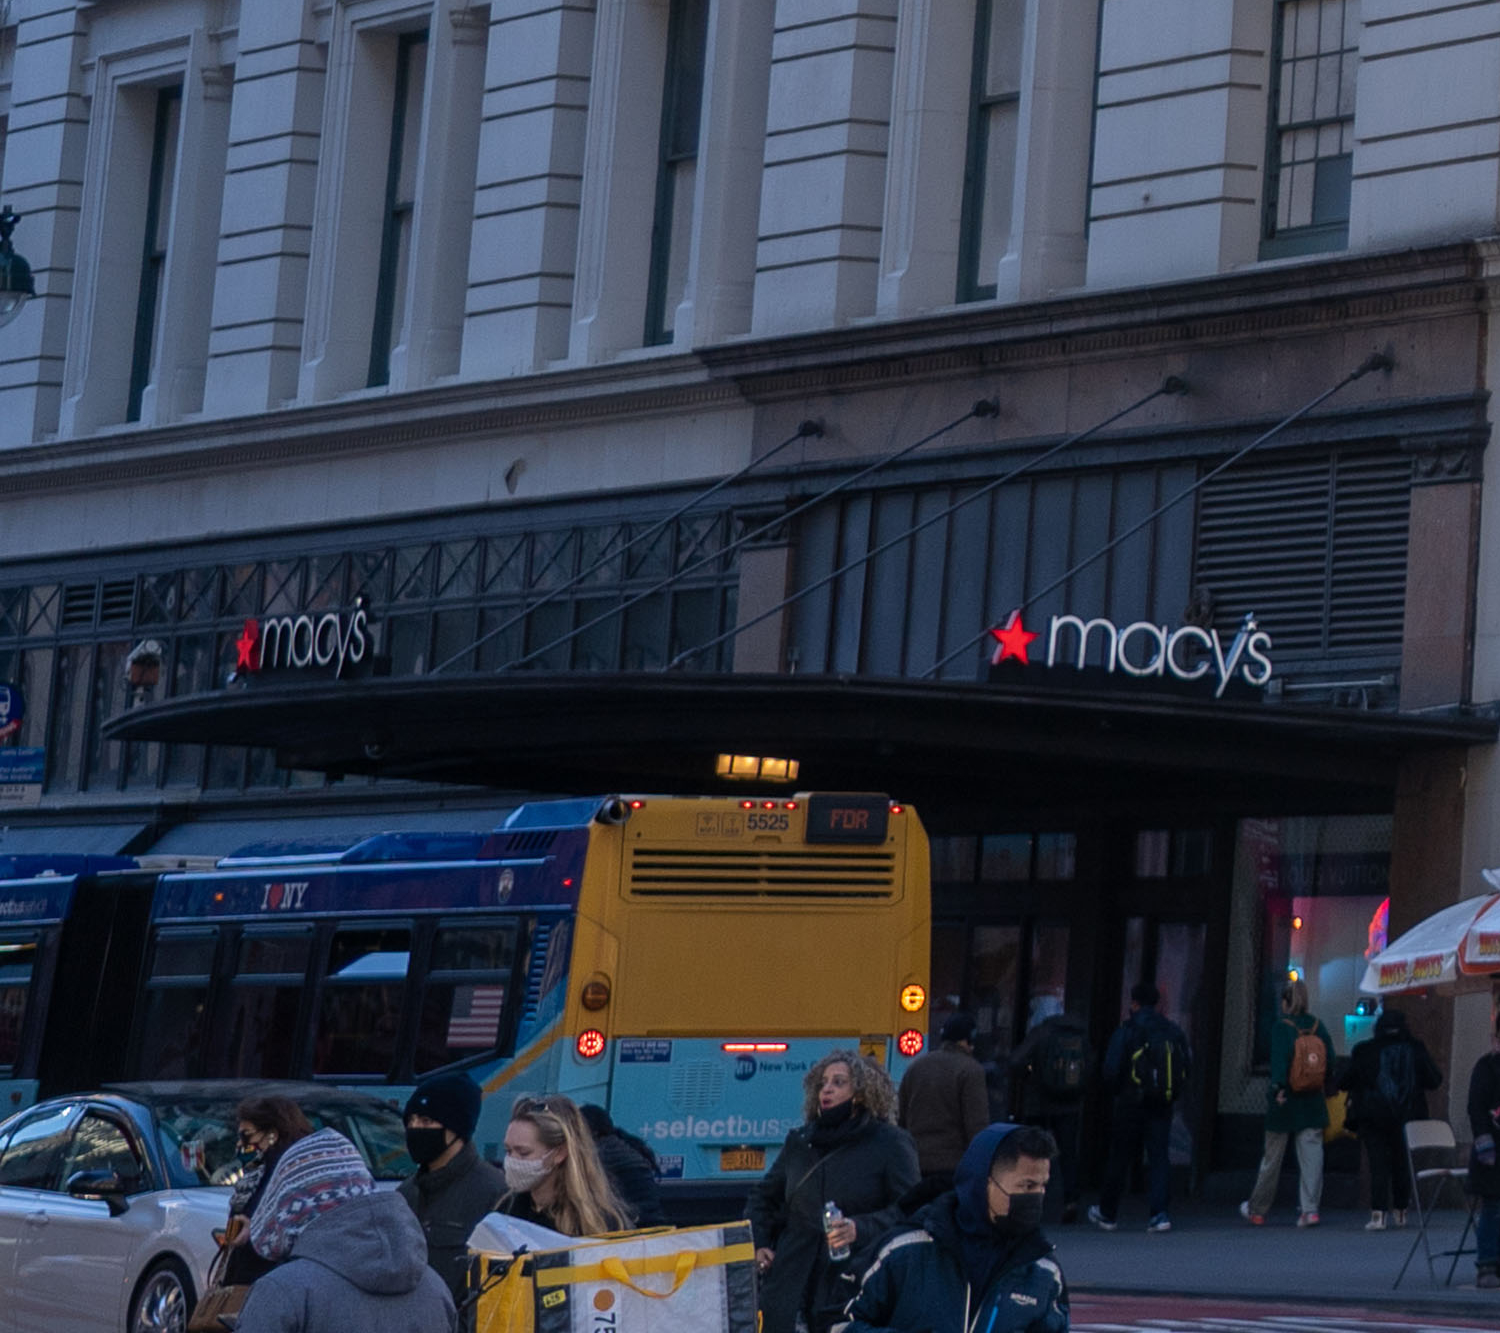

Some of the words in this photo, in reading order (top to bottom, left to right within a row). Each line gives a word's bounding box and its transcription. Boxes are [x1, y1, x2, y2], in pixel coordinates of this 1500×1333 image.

[746, 813, 789, 831] 5525
[829, 808, 869, 829] FDR
[260, 883, 268, 910] I
[280, 882, 309, 909] NY
[759, 1060, 783, 1073] New
[784, 1060, 807, 1073] York
